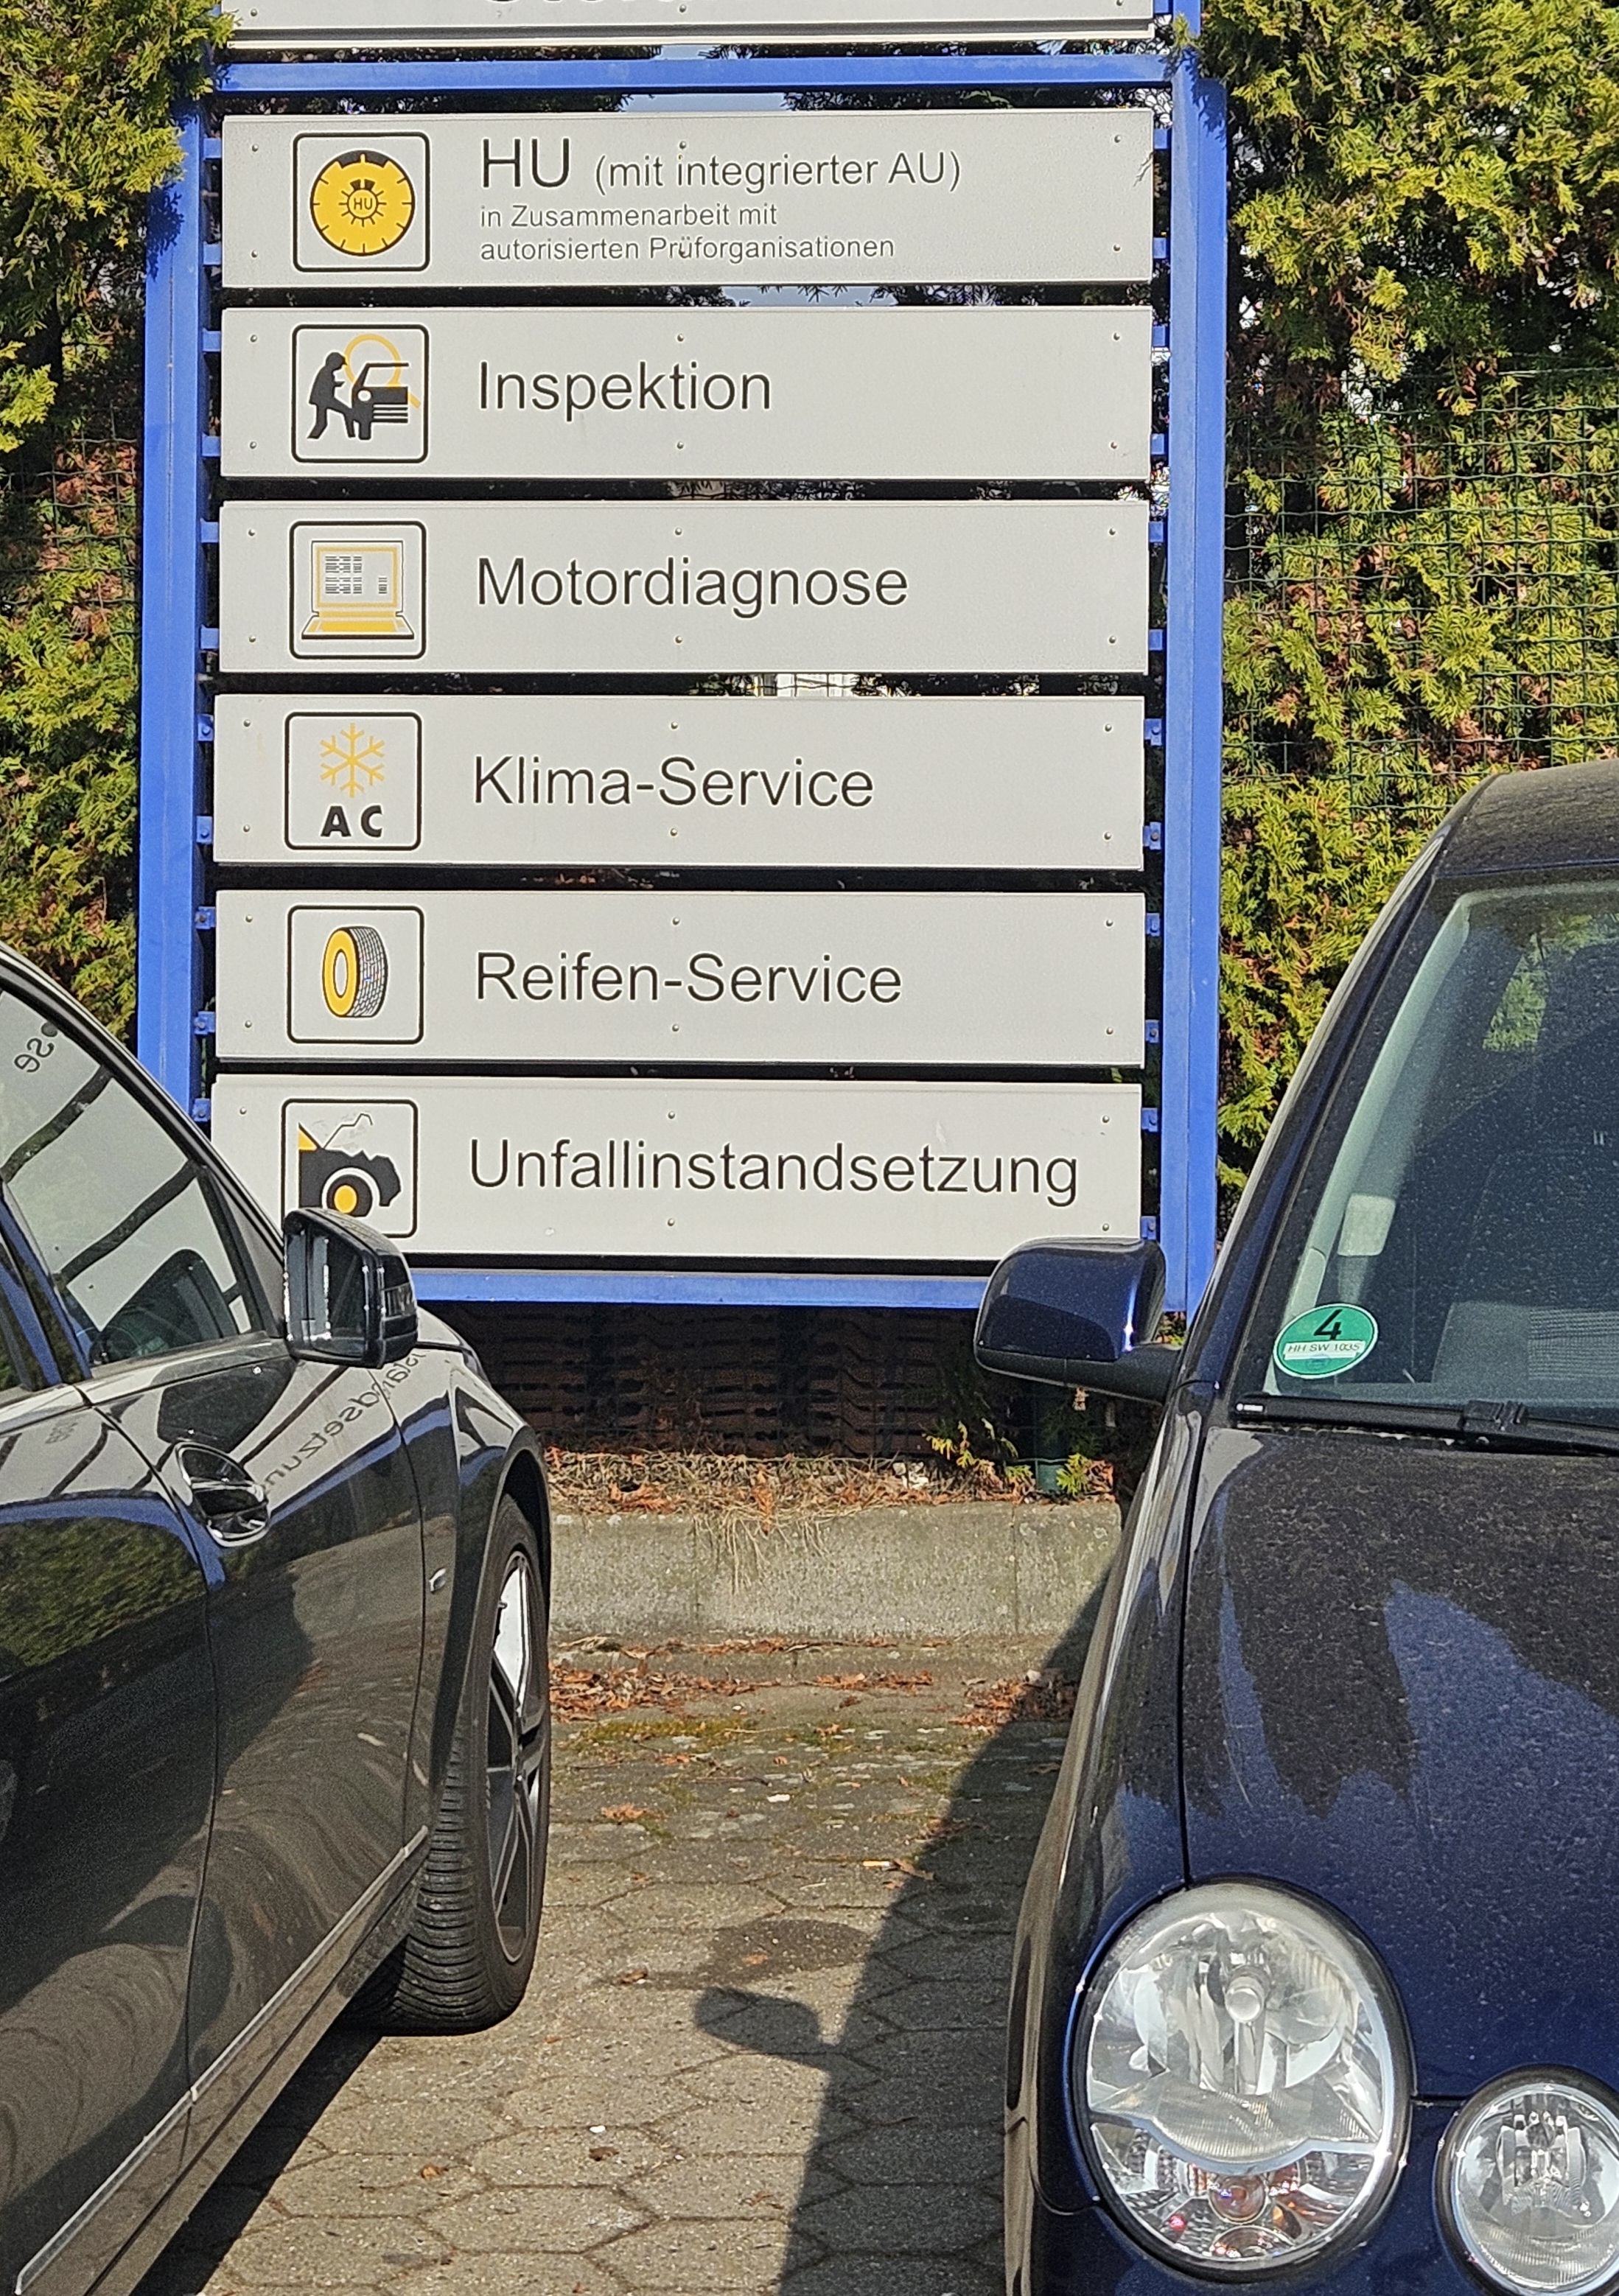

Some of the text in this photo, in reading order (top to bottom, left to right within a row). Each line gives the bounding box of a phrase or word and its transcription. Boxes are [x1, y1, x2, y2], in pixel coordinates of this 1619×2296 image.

[483, 139, 959, 196] HU (mit integrierter AU)
[353, 197, 374, 211] HU
[481, 203, 777, 227] in Zusammenarbeit mit
[480, 236, 894, 265] autorisierten Prüforganisationen
[480, 361, 770, 422] Inspektion
[479, 557, 908, 619] Motordiagnose
[475, 756, 873, 807] Klima-Service
[478, 951, 901, 1004] Reifen-Service
[471, 1138, 1077, 1208] Unfallinstandsetzung
[1287, 1344, 1307, 1353] HH
[1309, 1343, 1330, 1352] SW
[1313, 1309, 1343, 1340] 4
